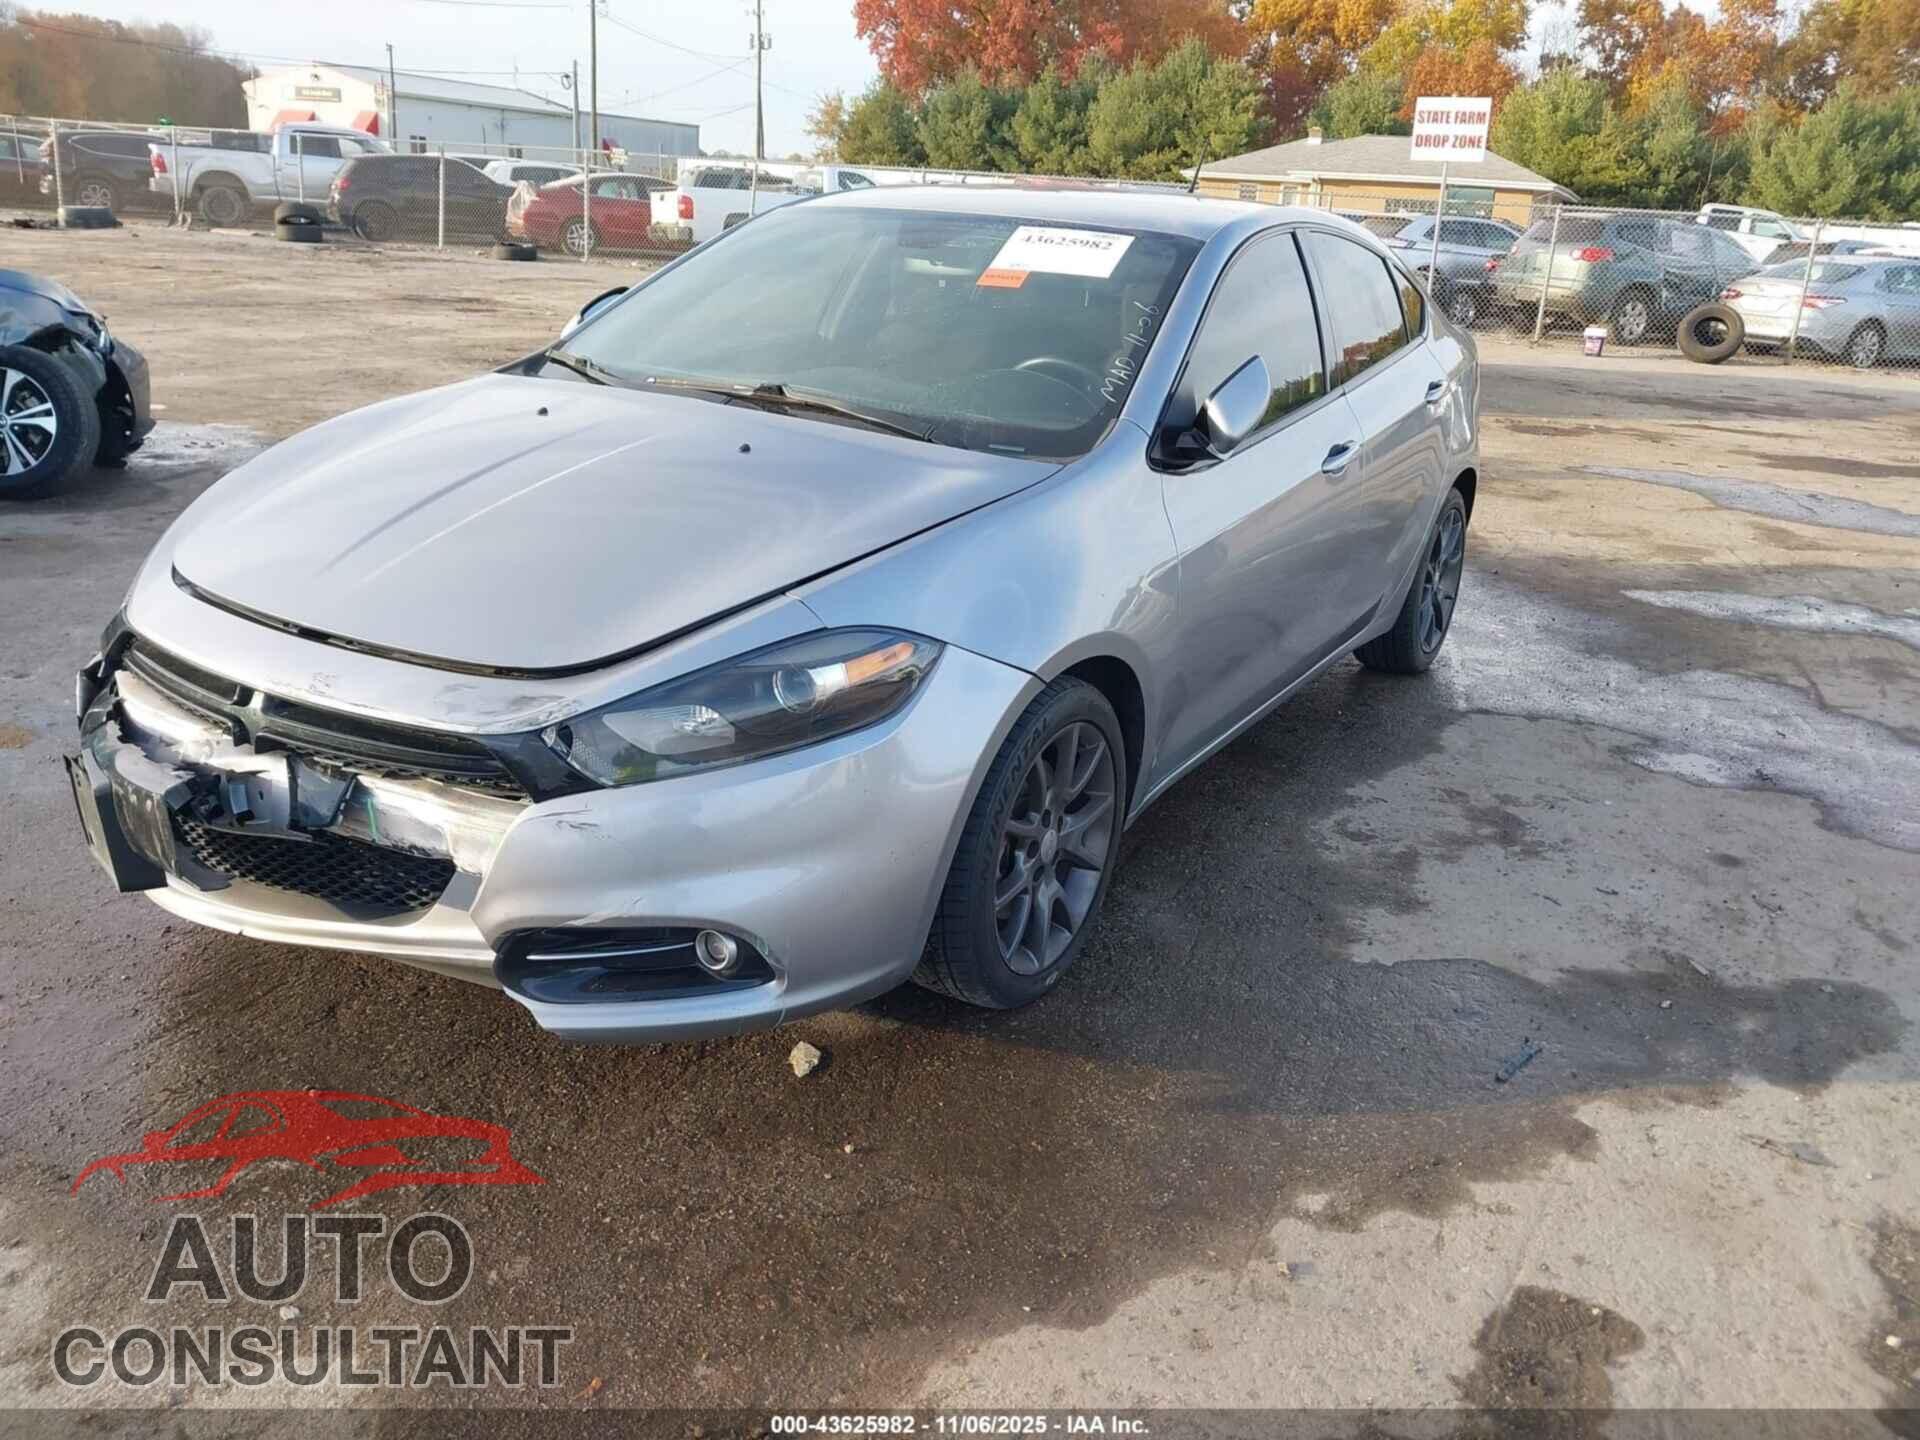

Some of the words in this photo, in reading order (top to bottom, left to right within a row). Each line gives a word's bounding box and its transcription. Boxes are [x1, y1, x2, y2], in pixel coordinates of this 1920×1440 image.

[1417, 109, 1451, 125] STATE
[1454, 110, 1487, 125] FARM
[1415, 133, 1450, 148] DROP
[1452, 134, 1485, 149] ZONE
[1100, 356, 1136, 404] MAD
